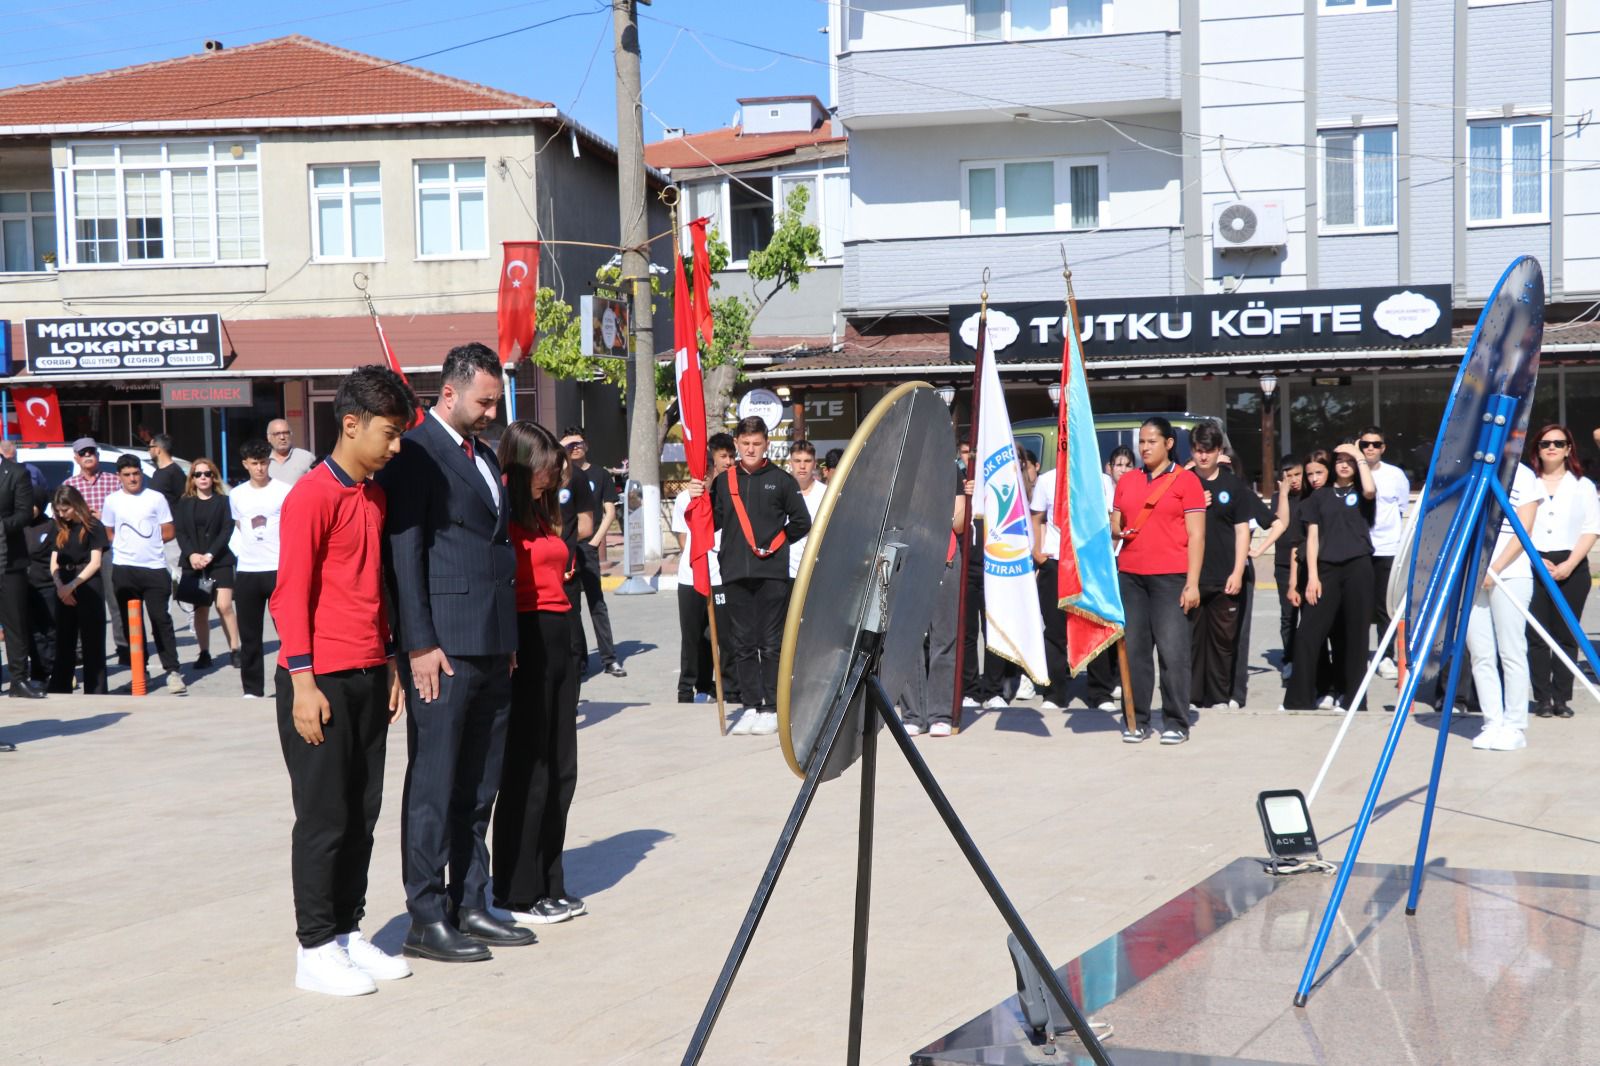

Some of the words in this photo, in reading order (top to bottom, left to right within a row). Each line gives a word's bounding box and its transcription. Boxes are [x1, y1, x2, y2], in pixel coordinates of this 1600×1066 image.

[37, 317, 209, 340] MALKOÇOĞLU
[1029, 311, 1192, 344] TUTKU
[1211, 301, 1362, 337] KÖFTE
[50, 338, 199, 355] LOKANTASI
